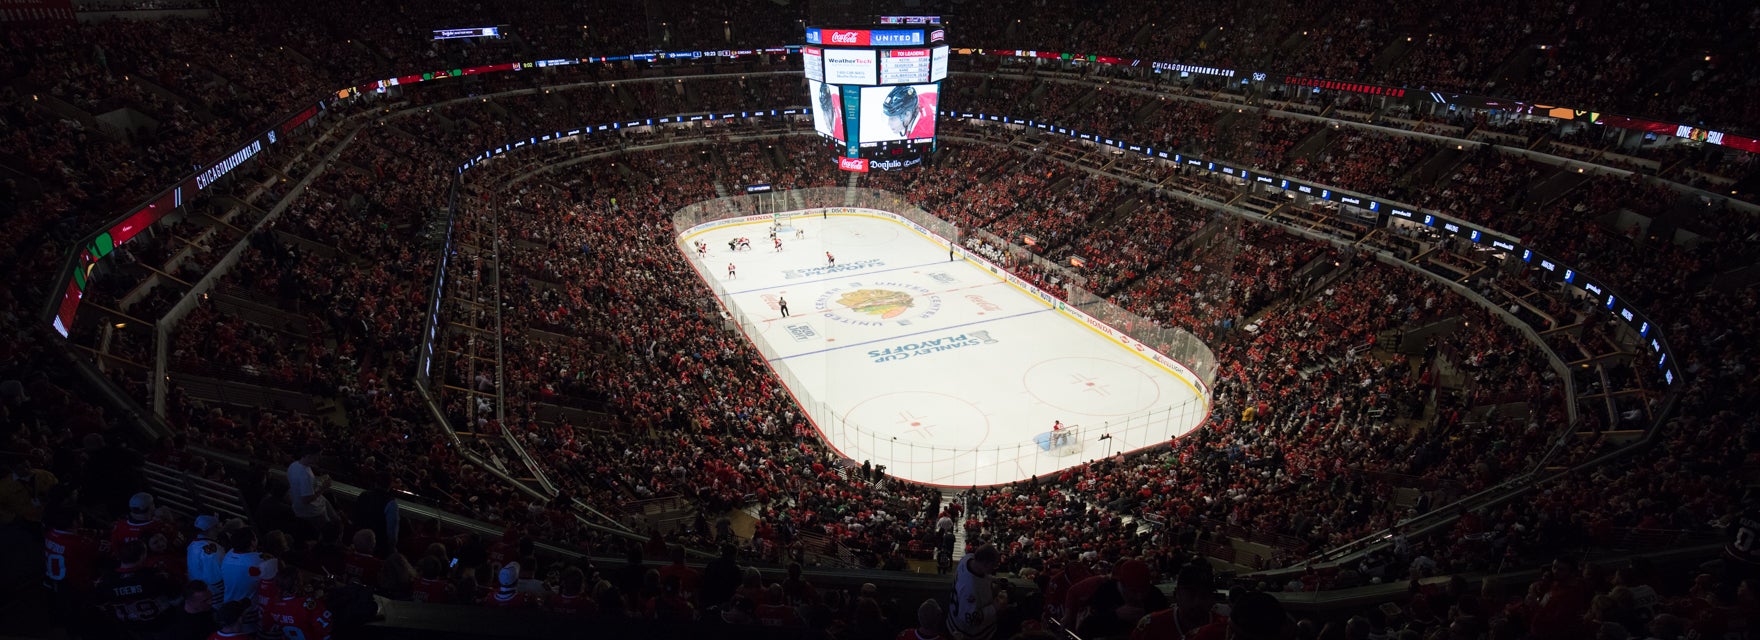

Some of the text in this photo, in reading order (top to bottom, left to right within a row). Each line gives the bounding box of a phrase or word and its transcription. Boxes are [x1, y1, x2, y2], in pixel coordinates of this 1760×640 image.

[1285, 75, 1405, 97] CHICAGOBLACKHAWKS.COM
[1676, 125, 1693, 138] ONE
[746, 214, 773, 222] HONDA
[874, 282, 930, 294] UNITED
[815, 287, 841, 311] CENTER
[920, 294, 942, 320] CENTER
[823, 312, 883, 327] UNITED
[1087, 317, 1113, 336] HONDA
[867, 333, 969, 359] PLAYOFFS
[874, 338, 981, 364] STANLEY CUP
